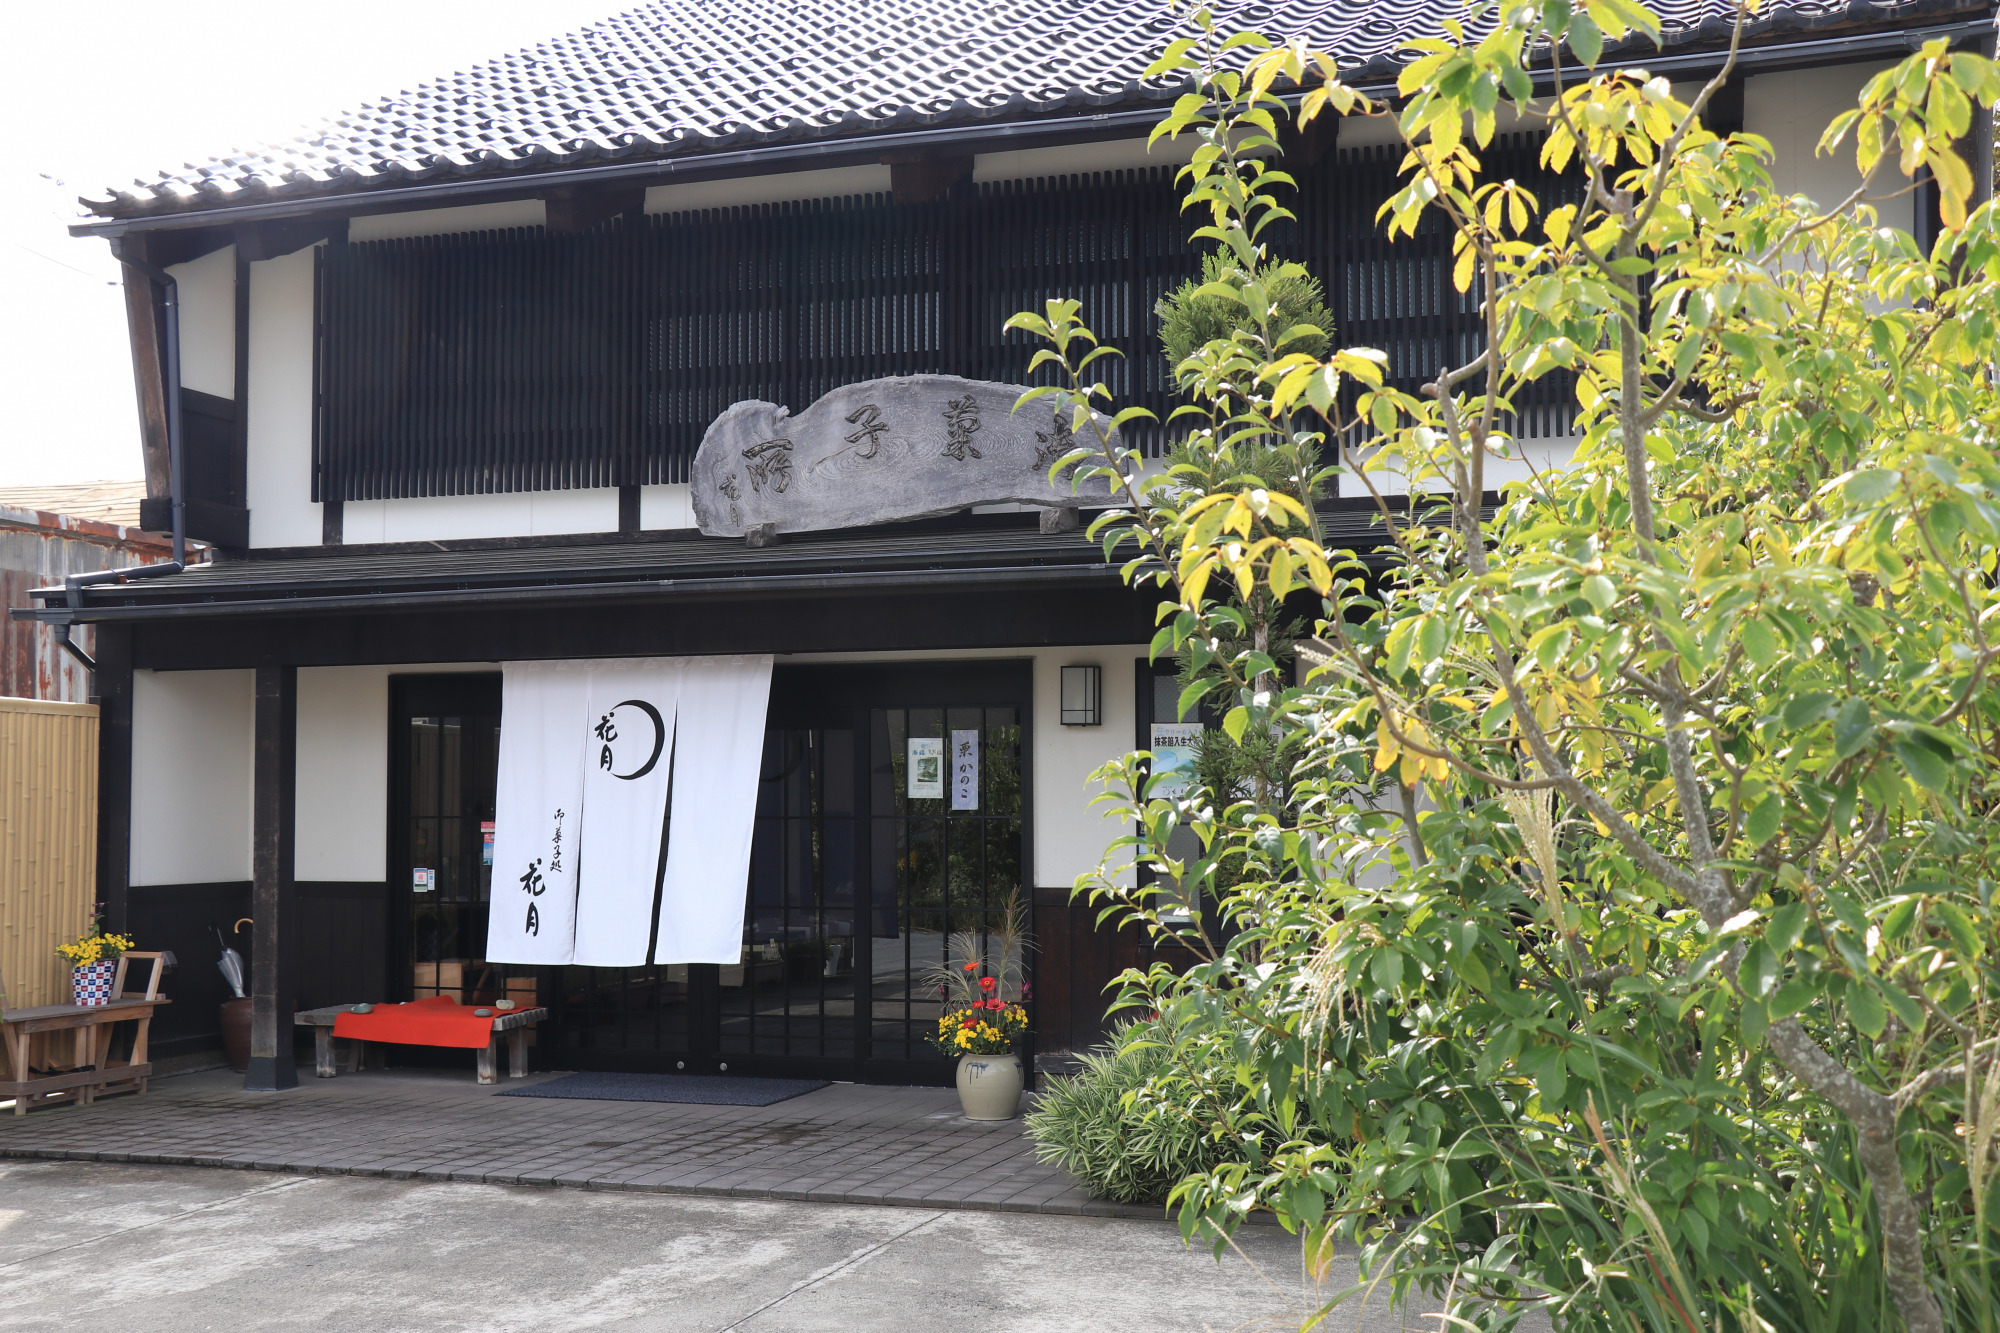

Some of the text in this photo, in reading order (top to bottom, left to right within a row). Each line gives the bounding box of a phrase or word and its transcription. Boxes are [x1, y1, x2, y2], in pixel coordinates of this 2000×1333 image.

[594, 711, 618, 772] 花月
[958, 741, 974, 799] 栗かのこ
[549, 808, 565, 873] 御菓子処
[520, 858, 546, 937] 花月
